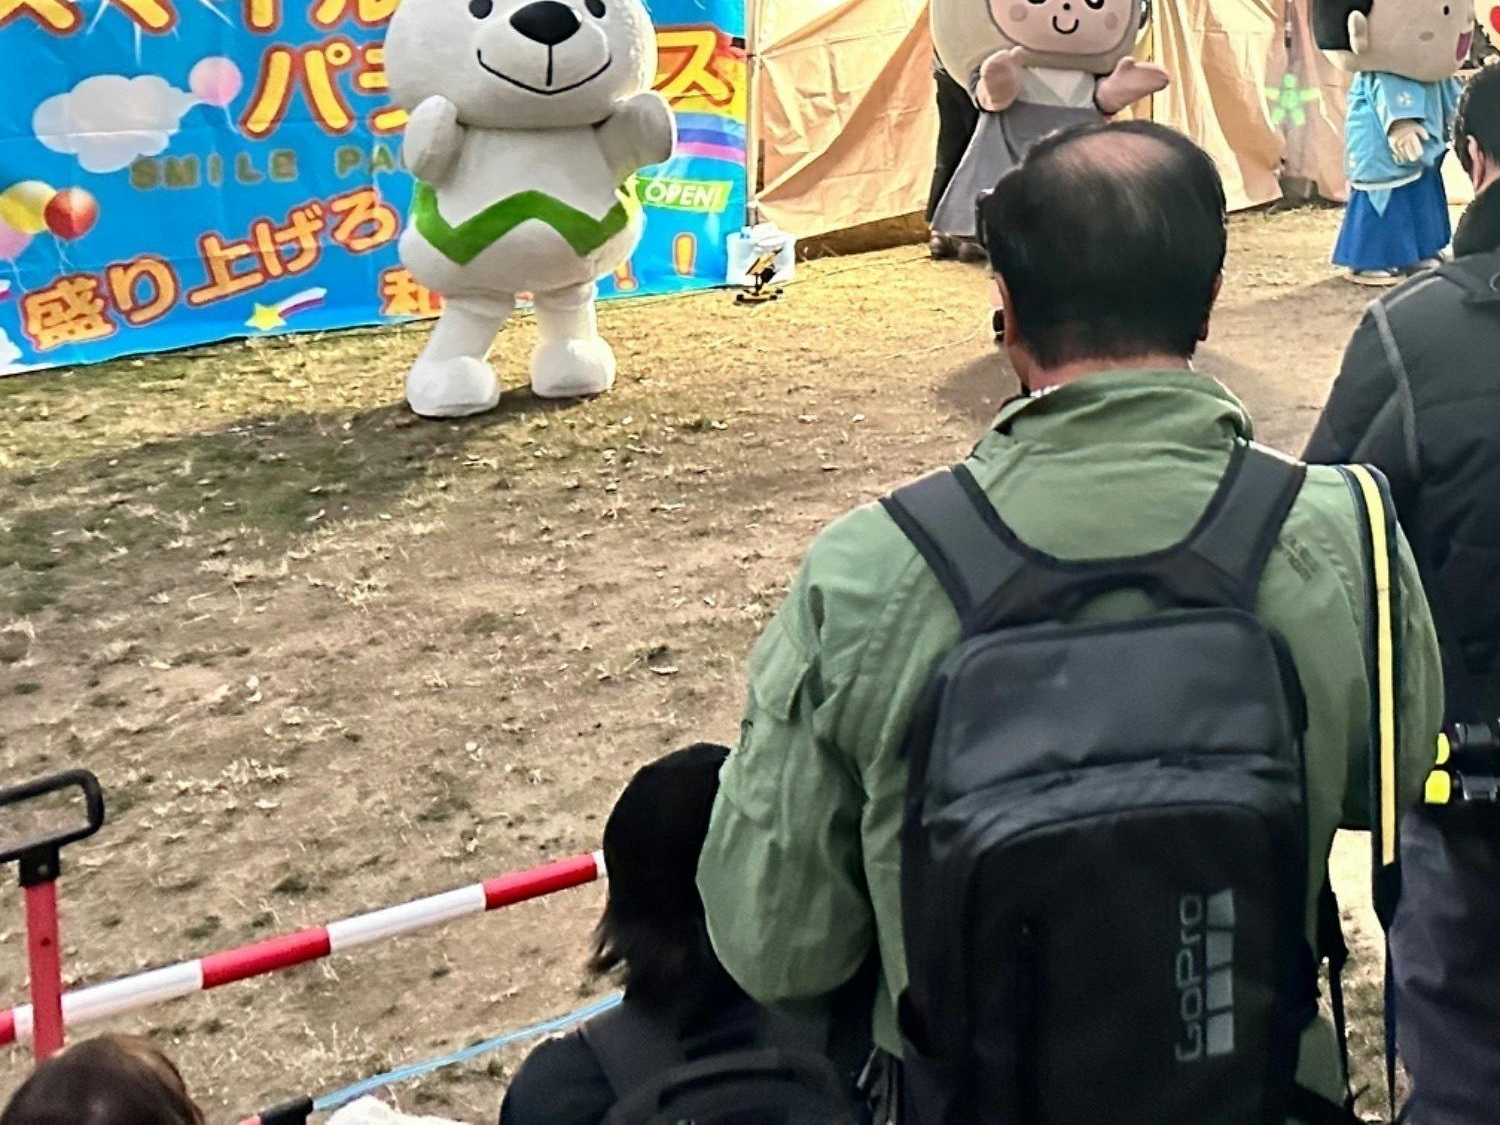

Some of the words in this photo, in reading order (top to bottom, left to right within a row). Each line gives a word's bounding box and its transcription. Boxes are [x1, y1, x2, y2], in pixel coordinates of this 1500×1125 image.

[336, 145, 407, 178] PA
[20, 187, 400, 351] 盛り上げろ
